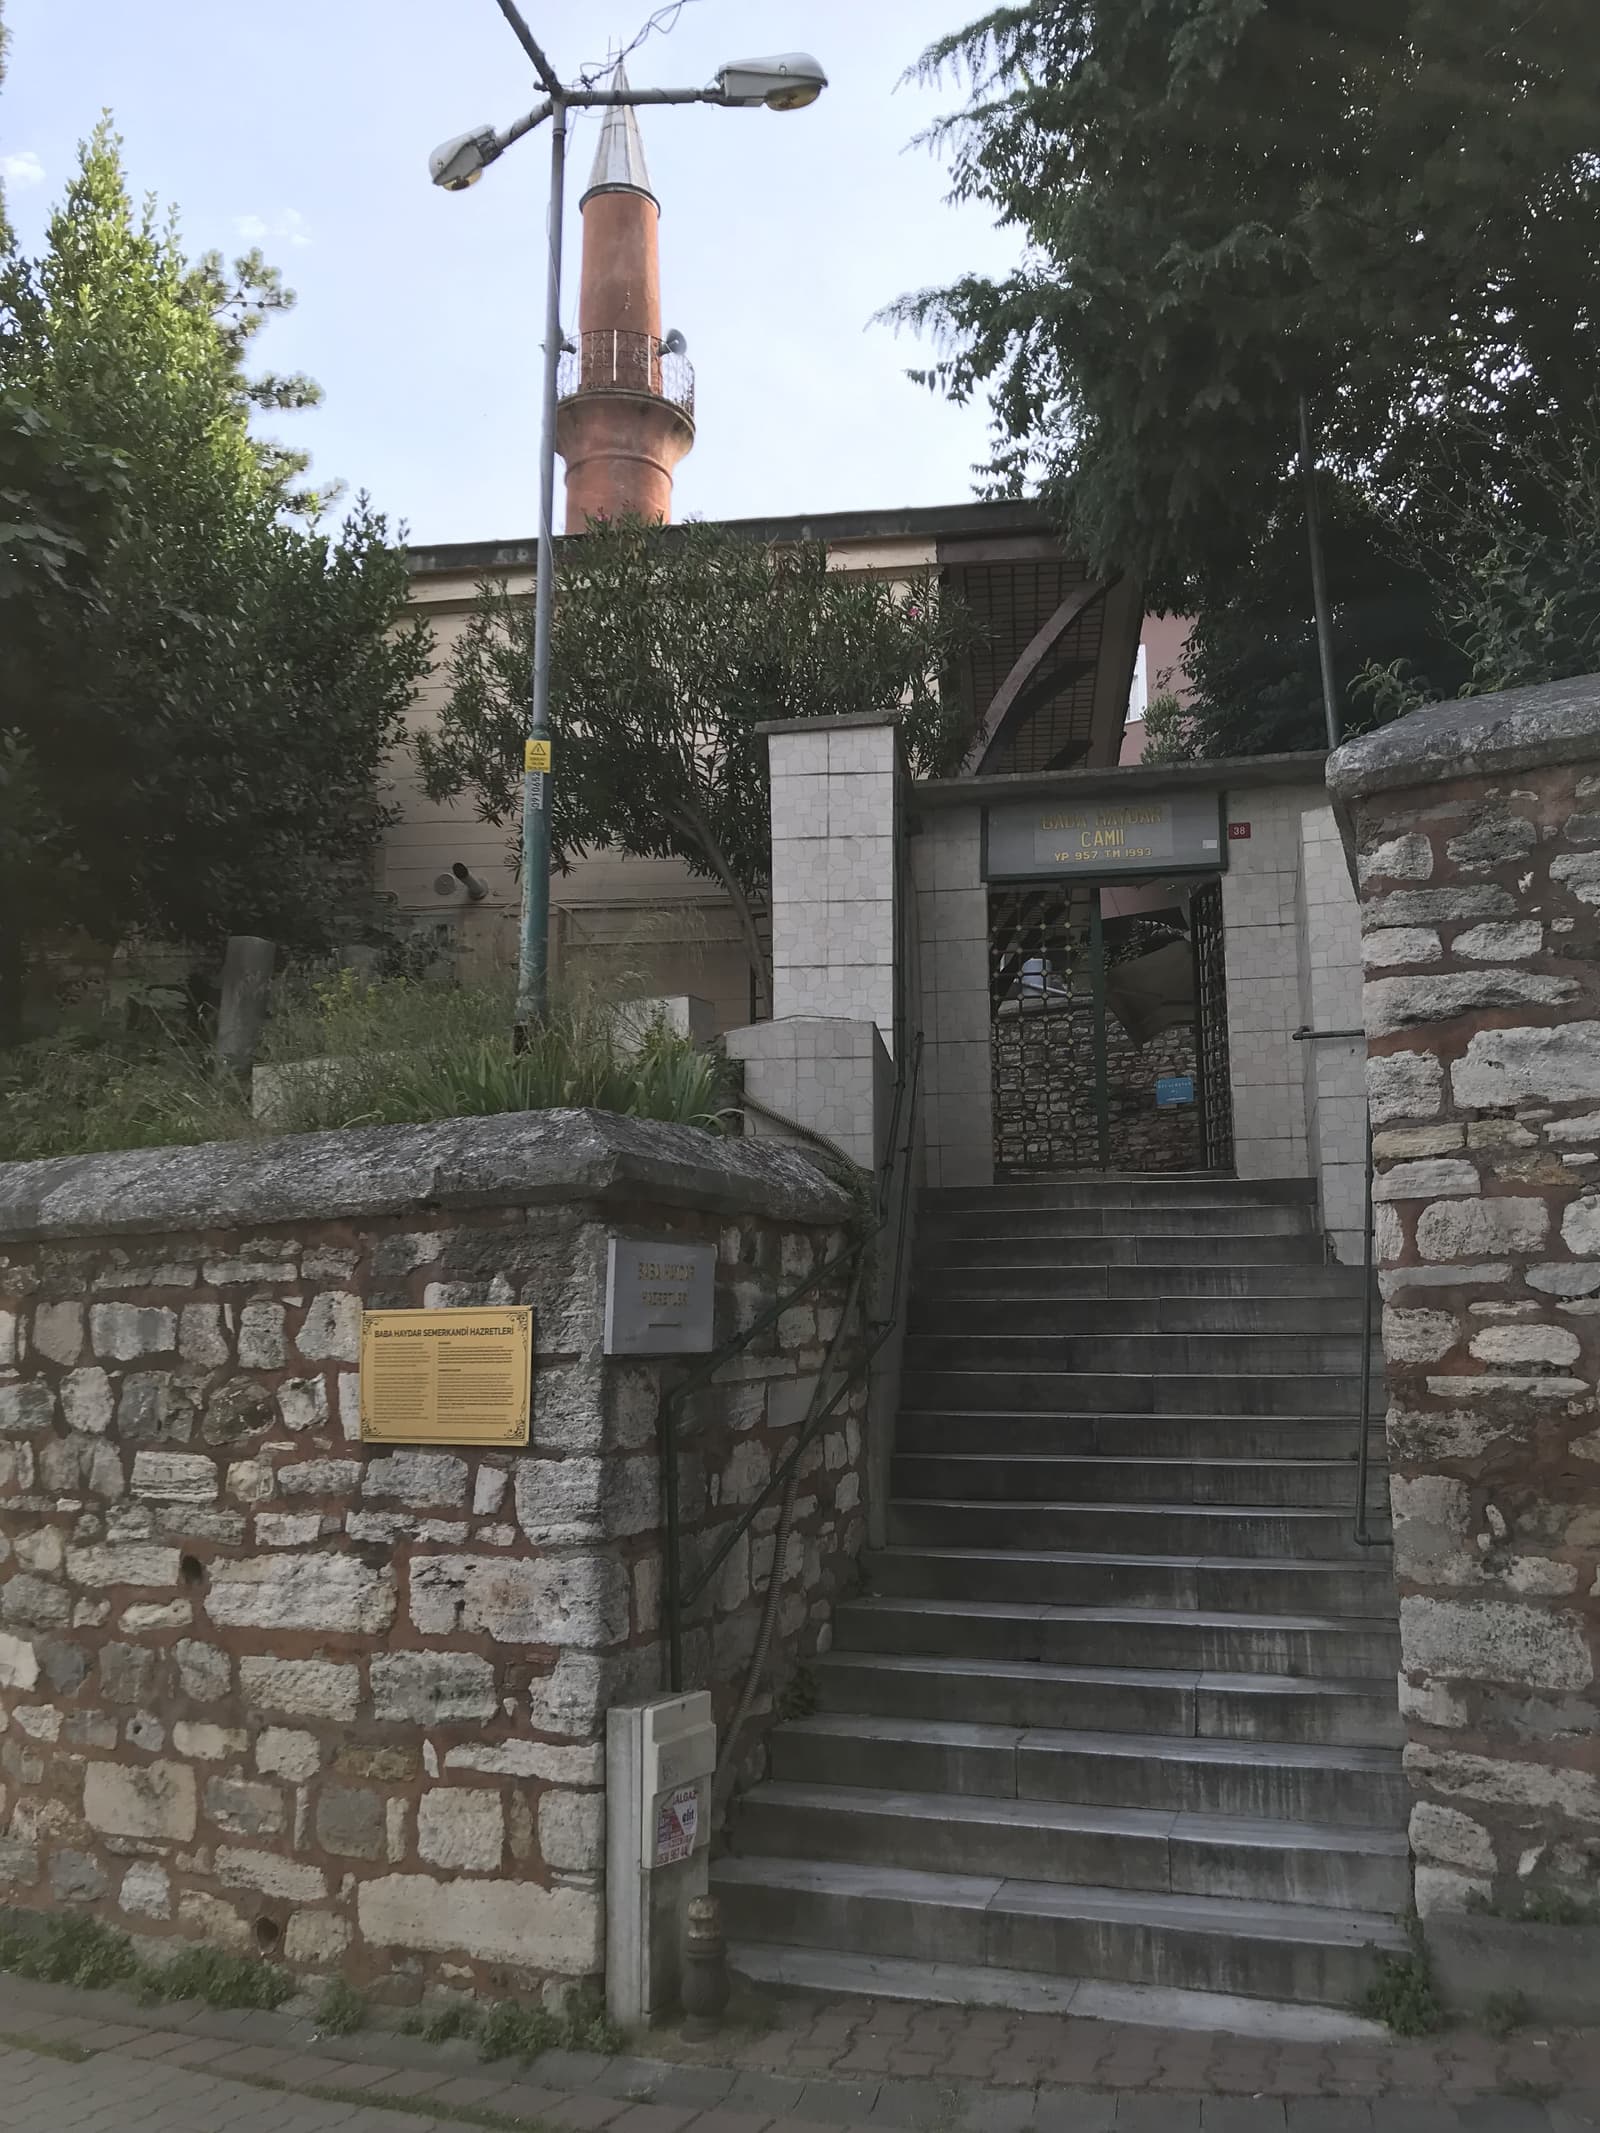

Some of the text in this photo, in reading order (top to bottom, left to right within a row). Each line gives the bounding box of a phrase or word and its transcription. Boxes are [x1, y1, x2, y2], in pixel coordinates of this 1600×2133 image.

[1233, 826, 1246, 836] 38
[1054, 847, 1153, 862] YP 957 TM 1993
[374, 1325, 514, 1338] BABA HAYDAR SEMERKANDİ HAZRETLERİ
